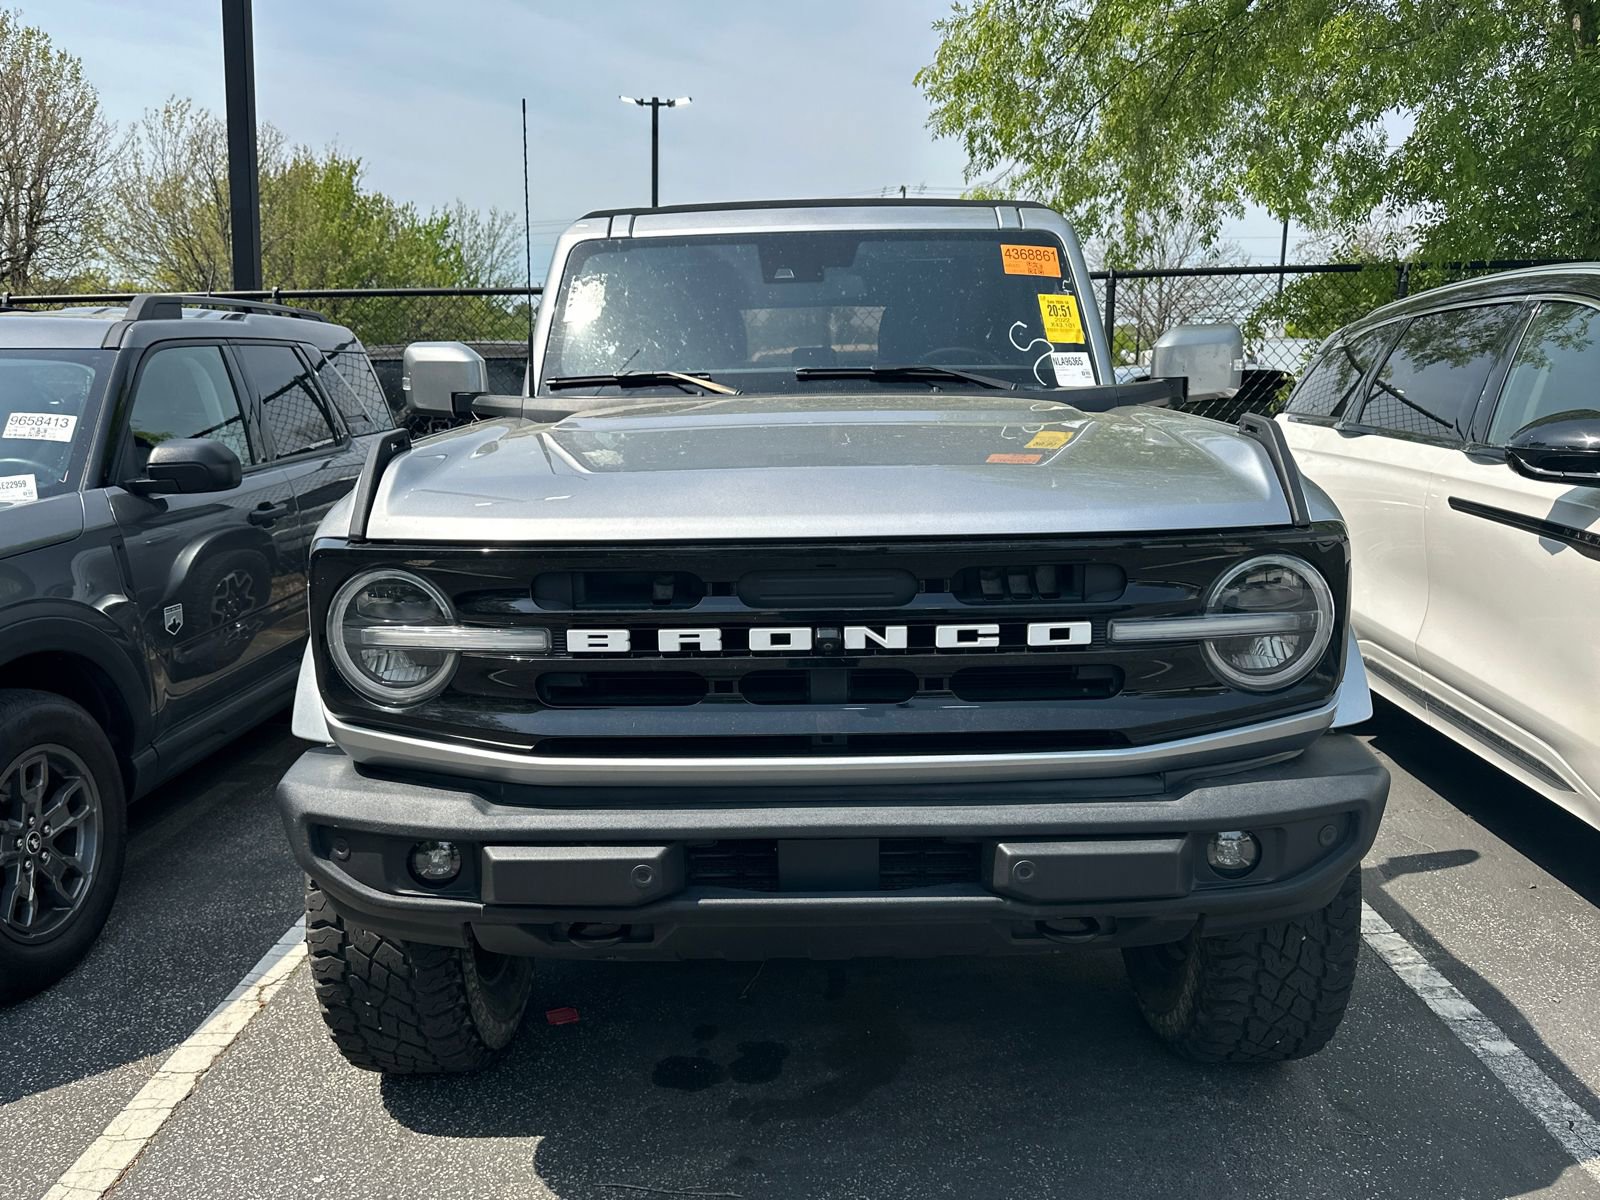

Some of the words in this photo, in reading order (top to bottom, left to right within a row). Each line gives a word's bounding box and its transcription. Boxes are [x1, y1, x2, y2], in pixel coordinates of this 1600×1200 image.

[1004, 248, 1057, 262] 4368861
[1047, 304, 1072, 318] 20:51
[9, 415, 70, 429] 9658413
[566, 621, 1092, 652] BRONCO
